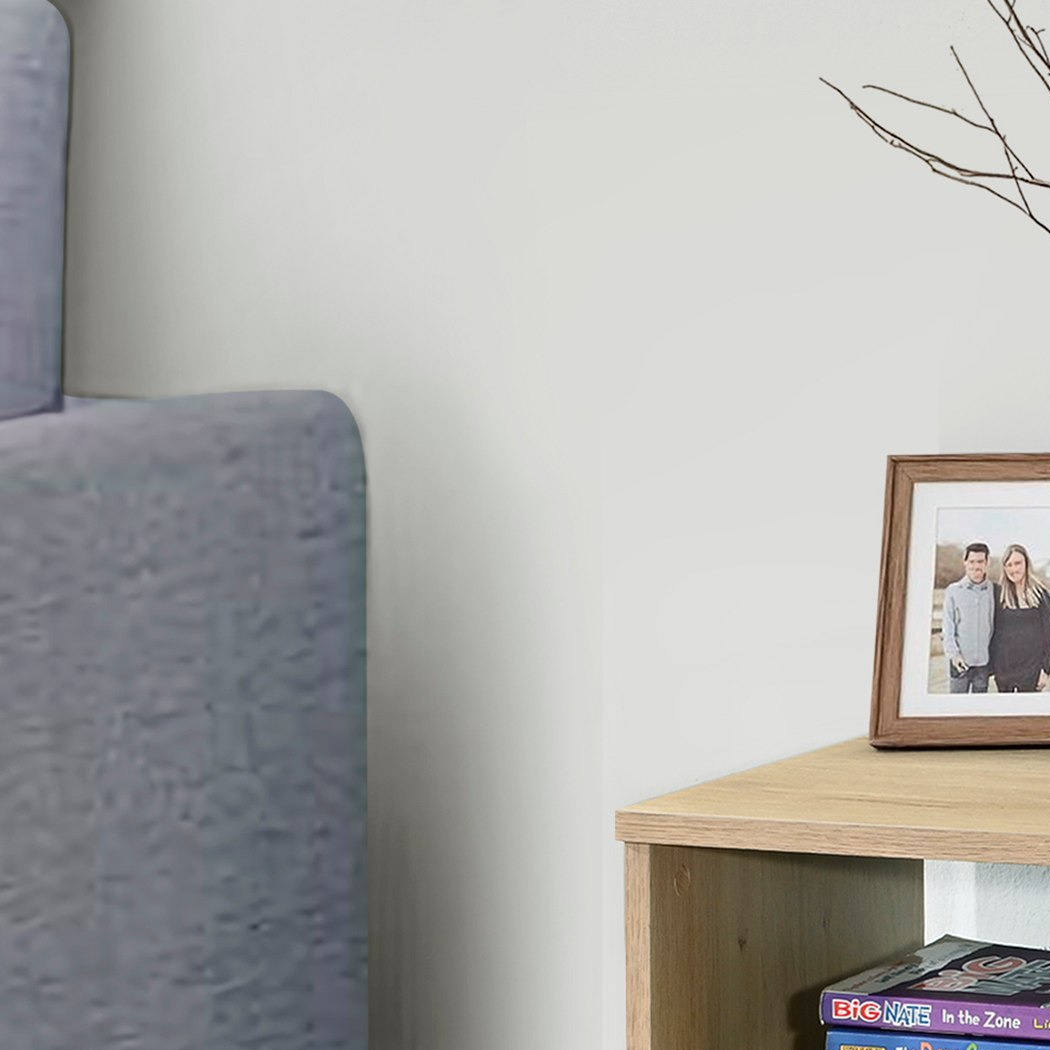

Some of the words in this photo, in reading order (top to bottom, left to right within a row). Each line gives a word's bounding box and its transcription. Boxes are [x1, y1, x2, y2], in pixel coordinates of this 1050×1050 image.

[883, 1000, 932, 1027] NATE
[942, 1008, 954, 1024] In
[957, 1010, 980, 1026] the
[983, 1011, 1021, 1029] Zone
